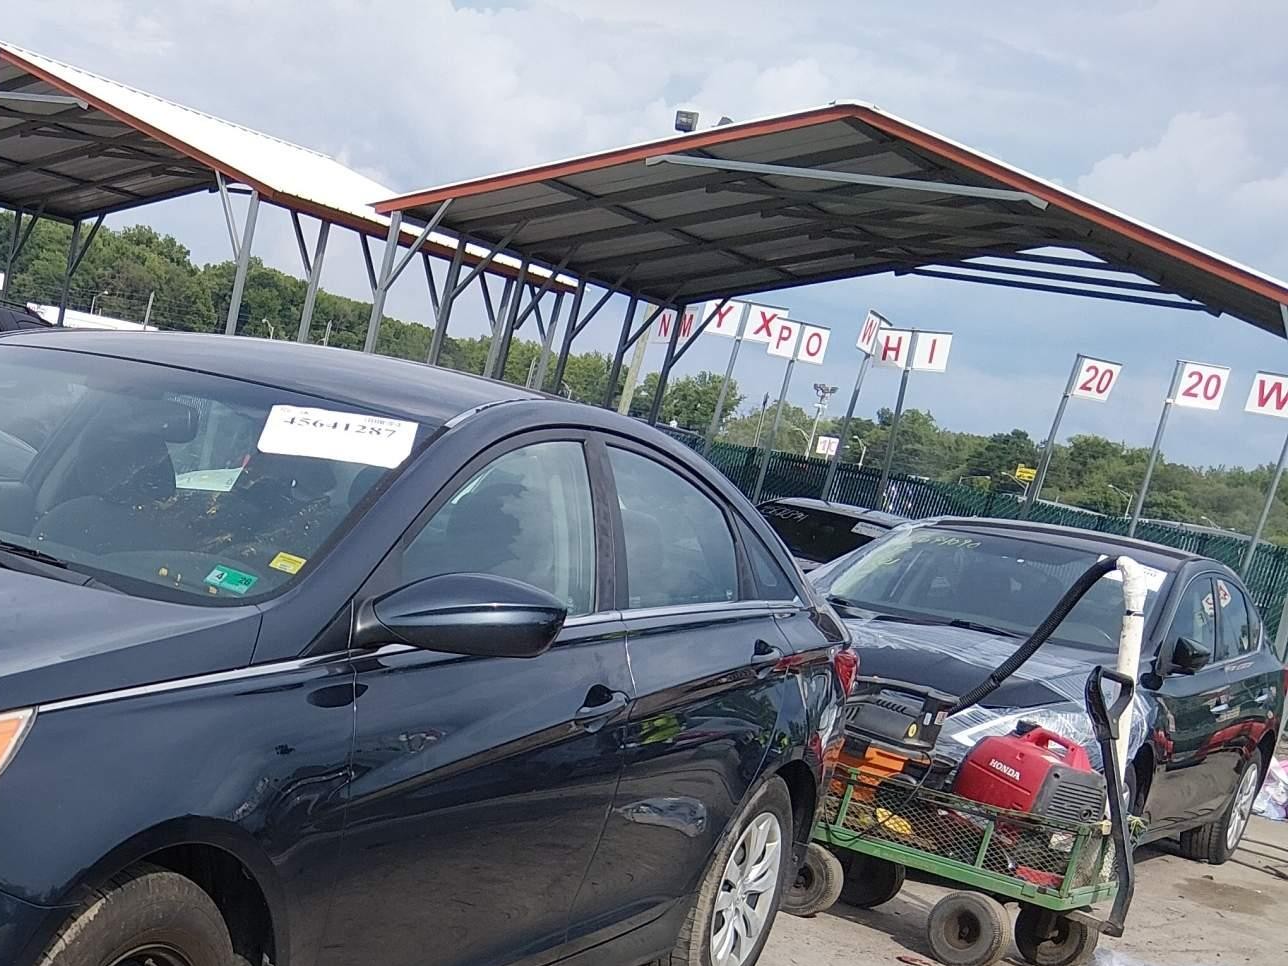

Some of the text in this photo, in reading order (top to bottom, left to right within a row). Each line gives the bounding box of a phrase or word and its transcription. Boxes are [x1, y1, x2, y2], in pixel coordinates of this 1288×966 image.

[657, 313, 672, 338] N
[714, 303, 778, 338] Y X
[775, 325, 823, 357] P O
[881, 335, 903, 361] H
[1079, 364, 1115, 395] 20
[1181, 370, 1223, 401] 20
[283, 416, 396, 438] 45641287
[988, 758, 1021, 780] HONDA
